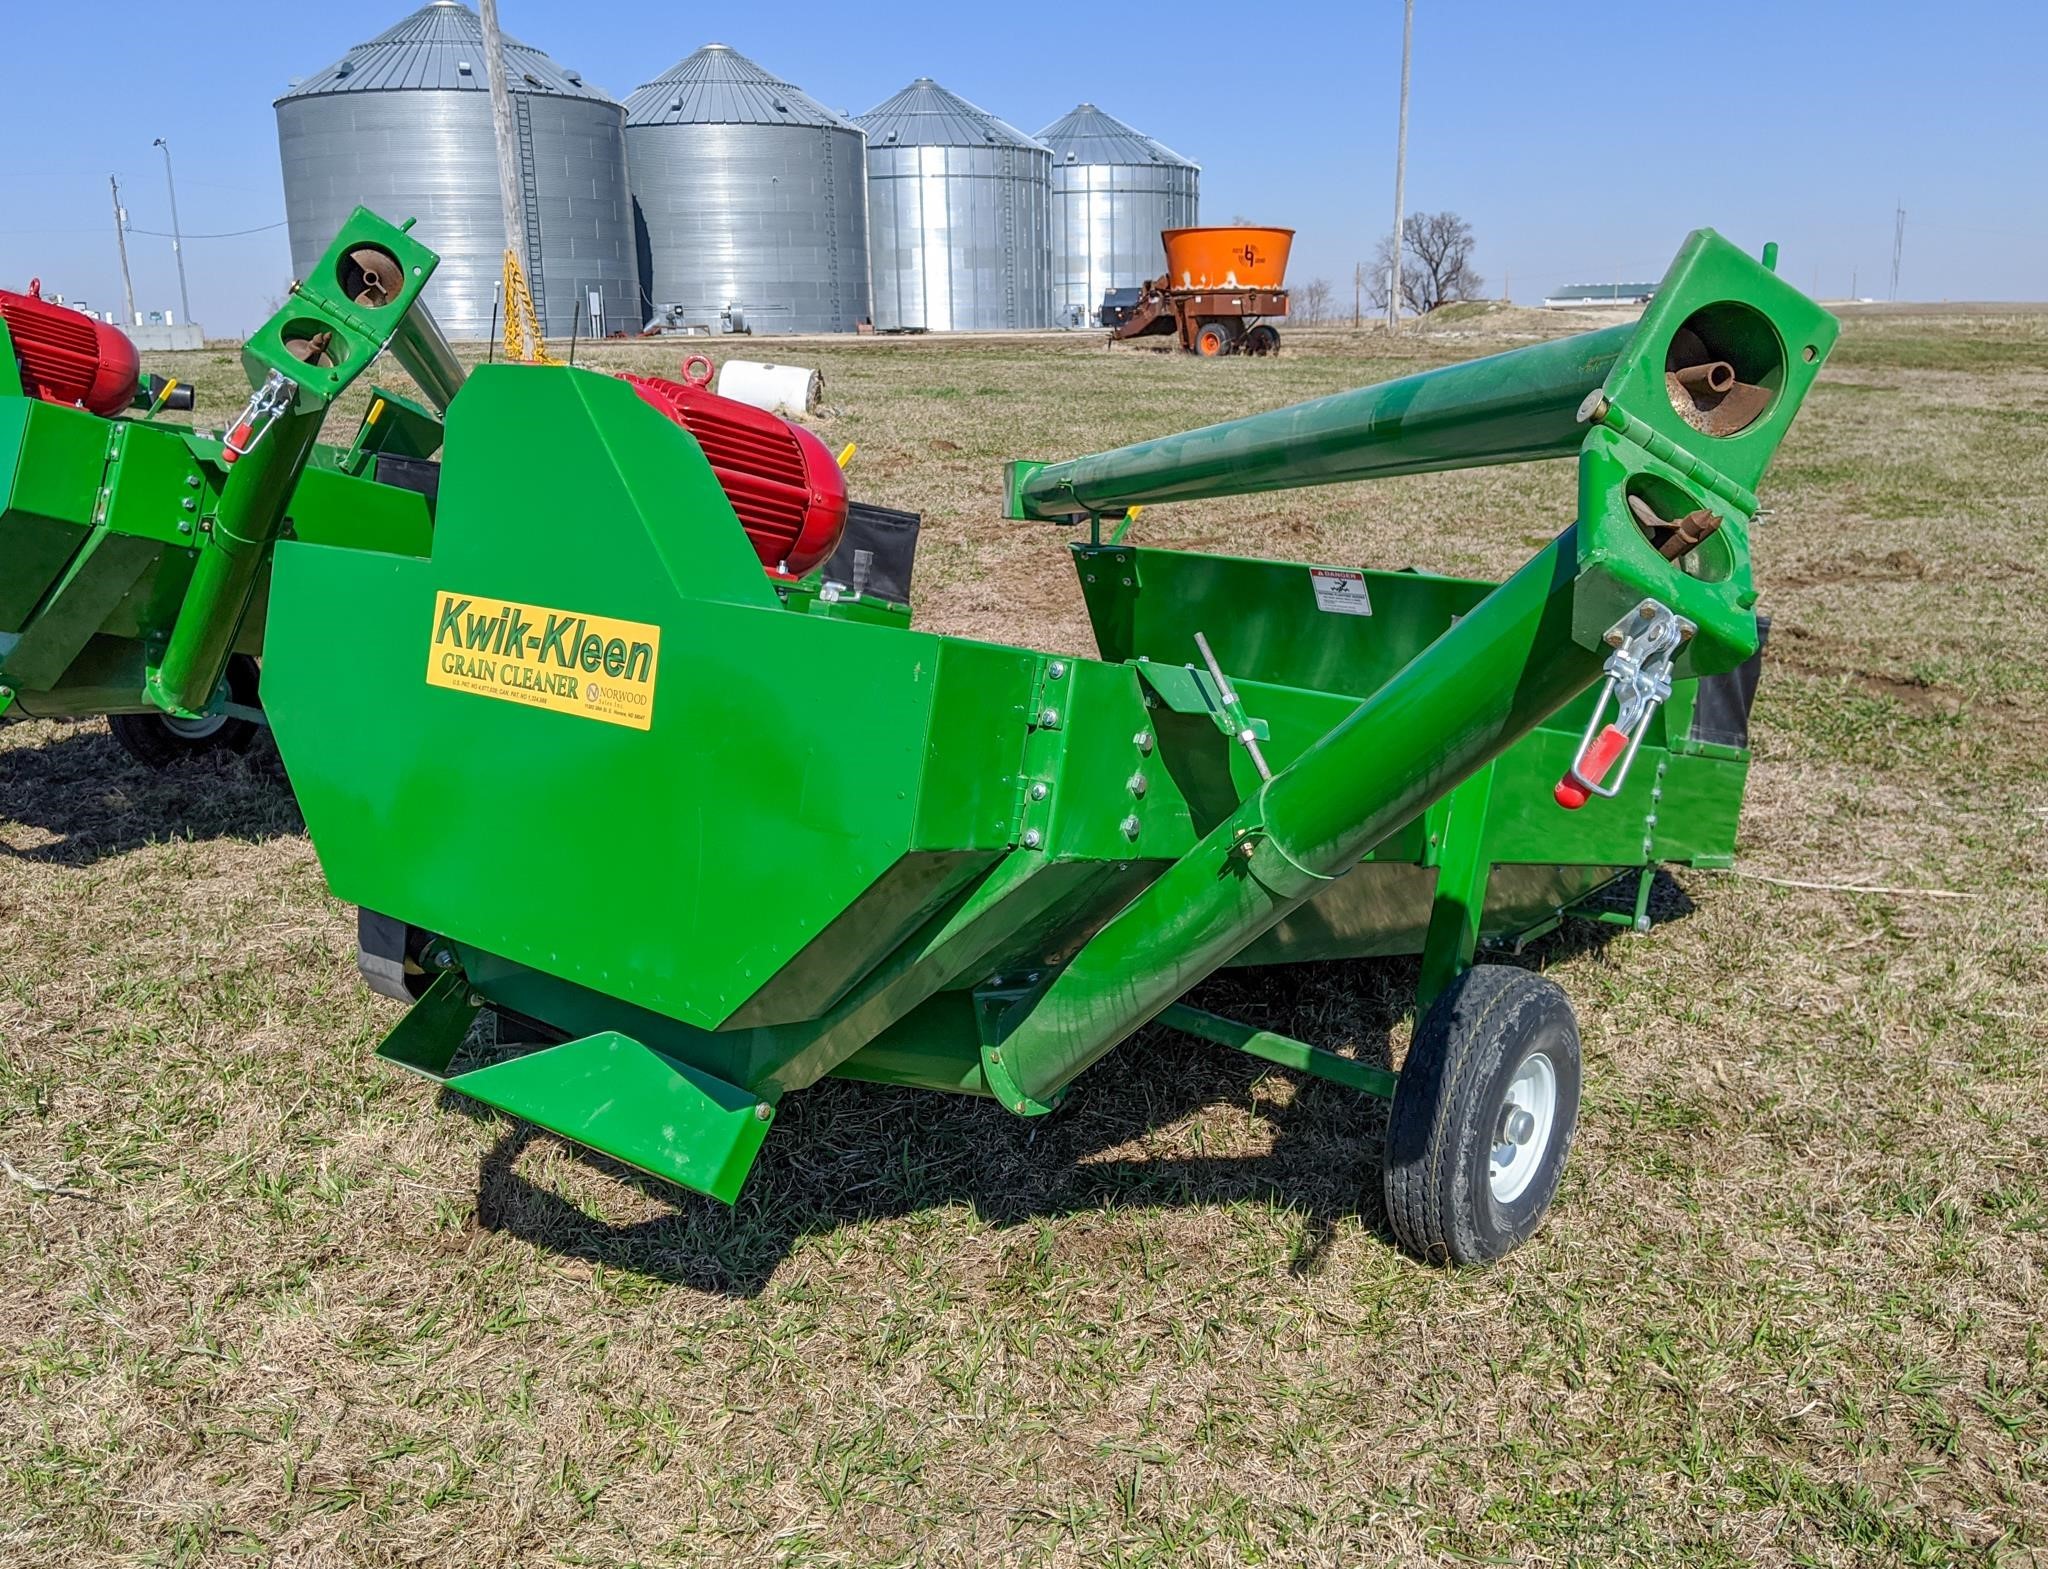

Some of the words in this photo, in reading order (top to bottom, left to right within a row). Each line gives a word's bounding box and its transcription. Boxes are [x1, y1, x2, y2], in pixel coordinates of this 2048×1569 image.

[1324, 571, 1356, 579] DANGER
[435, 597, 653, 683] Kwik-Kleen
[441, 652, 497, 682] GRAIN
[500, 663, 579, 700] CLEANER
[600, 687, 647, 705] NORWOOD
